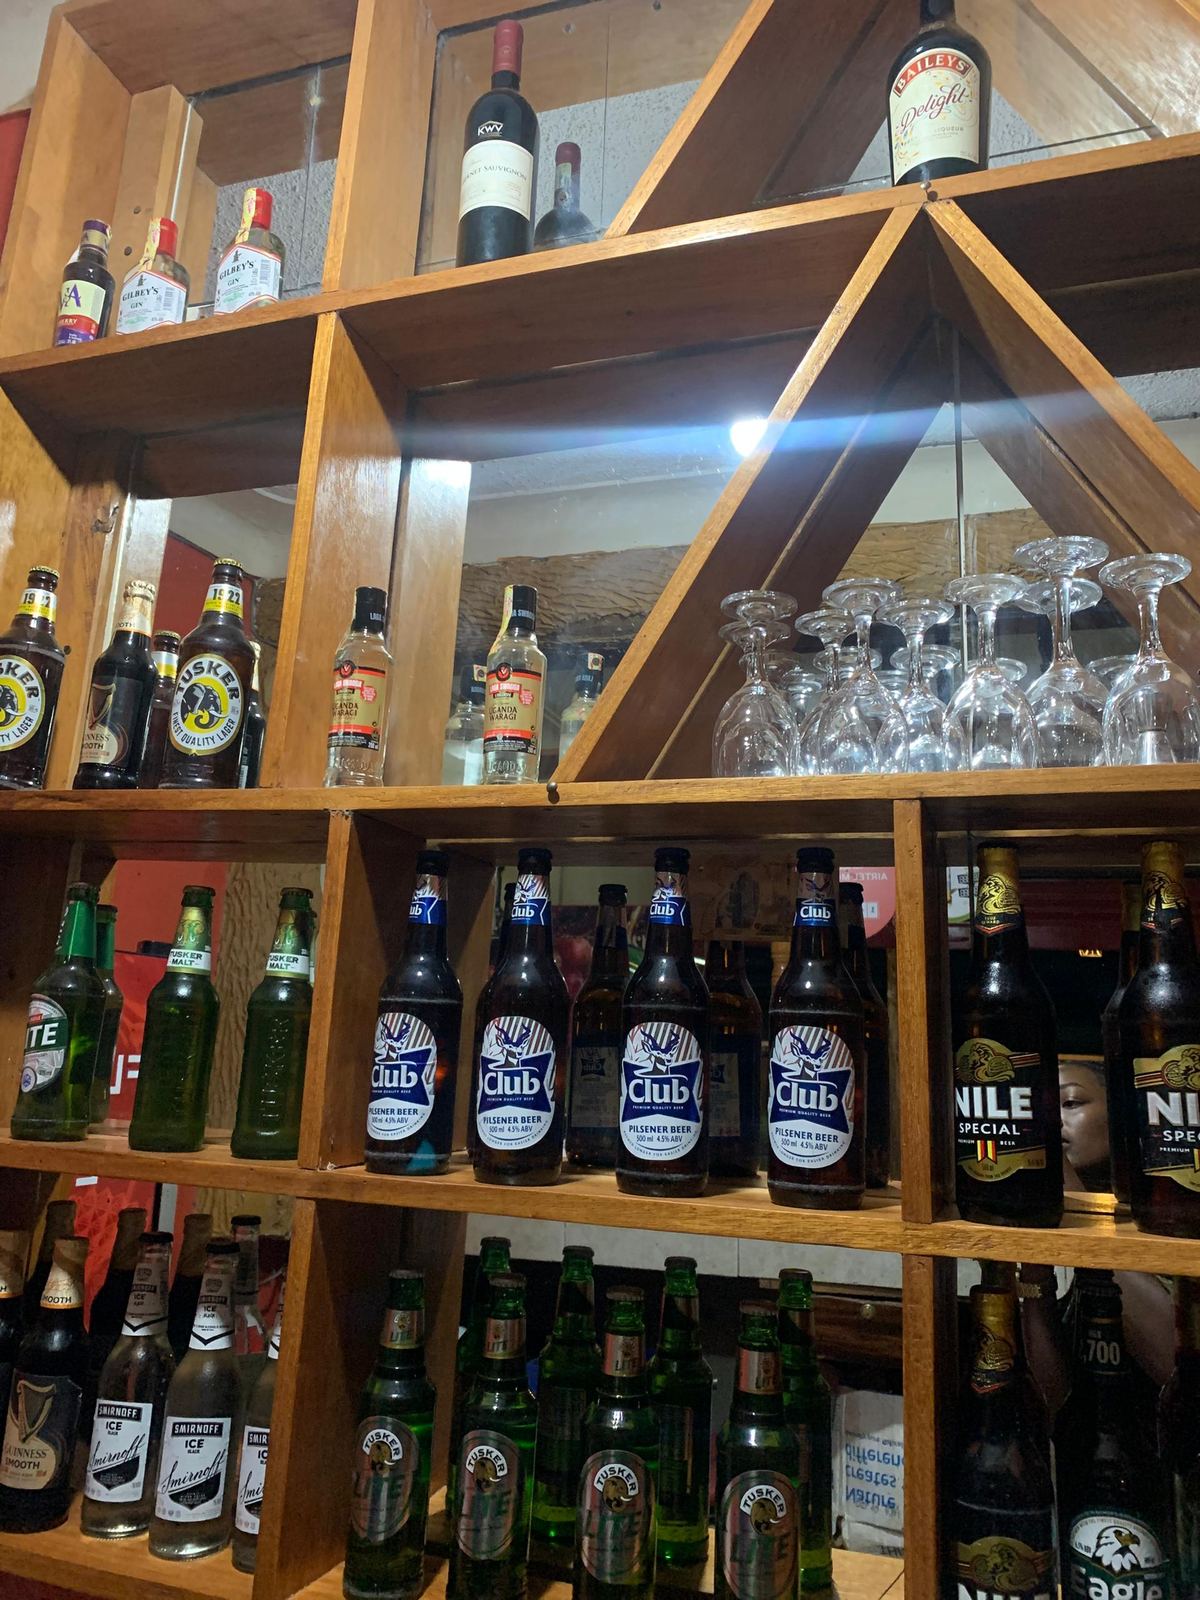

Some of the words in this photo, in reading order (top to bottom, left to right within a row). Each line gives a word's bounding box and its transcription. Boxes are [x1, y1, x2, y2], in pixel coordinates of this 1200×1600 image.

[896, 54, 967, 90] BAILEYS
[899, 82, 968, 132] Delight
[477, 124, 503, 136] KWV
[219, 259, 254, 281] GILBEY'S
[227, 277, 240, 287] GIN
[122, 286, 159, 302] GILBEY'S
[130, 301, 143, 309] GIN
[213, 588, 241, 605] 1922
[175, 660, 240, 699] TUSKER
[12, 716, 34, 738] LAGER
[172, 711, 183, 738] FINEST
[181, 732, 215, 747] QUALITY
[216, 718, 236, 741] LAGER
[649, 903, 675, 916] Club
[800, 905, 831, 919] Club
[171, 958, 195, 966] MALT
[269, 962, 291, 970] MALT
[371, 1064, 418, 1089] Club
[483, 1068, 540, 1096] Club
[628, 1078, 689, 1104] Club
[775, 1081, 838, 1111] Club
[955, 1086, 1033, 1120] NILE
[397, 1108, 419, 1116] BEER
[483, 1116, 519, 1124] PILSENER
[520, 1115, 542, 1124] BEER
[520, 1125, 533, 1133] ABV
[629, 1124, 669, 1133] PILSENER
[670, 1125, 692, 1134] BEER
[775, 1127, 813, 1140] PILSENER
[815, 1133, 839, 1143] BEER
[959, 1122, 1021, 1135] SPECIAL
[670, 1135, 683, 1143] ABV
[781, 1138, 790, 1146] 500
[800, 1141, 814, 1149] 4.5%
[814, 1143, 828, 1151] ABV
[1086, 1339, 1121, 1366] 700
[98, 1405, 138, 1419] SMIRNOFF
[105, 1421, 123, 1431] ICE
[174, 1424, 220, 1434] SMIRNOFF
[184, 1439, 205, 1449] ICE
[363, 1429, 401, 1457] TUSKER
[5, 1457, 40, 1470] SMOOTH
[467, 1448, 506, 1473] TUSKER
[161, 1448, 226, 1494] Smirnoff
[596, 1465, 637, 1492] TUSKER
[743, 1487, 785, 1515] TUSKER
